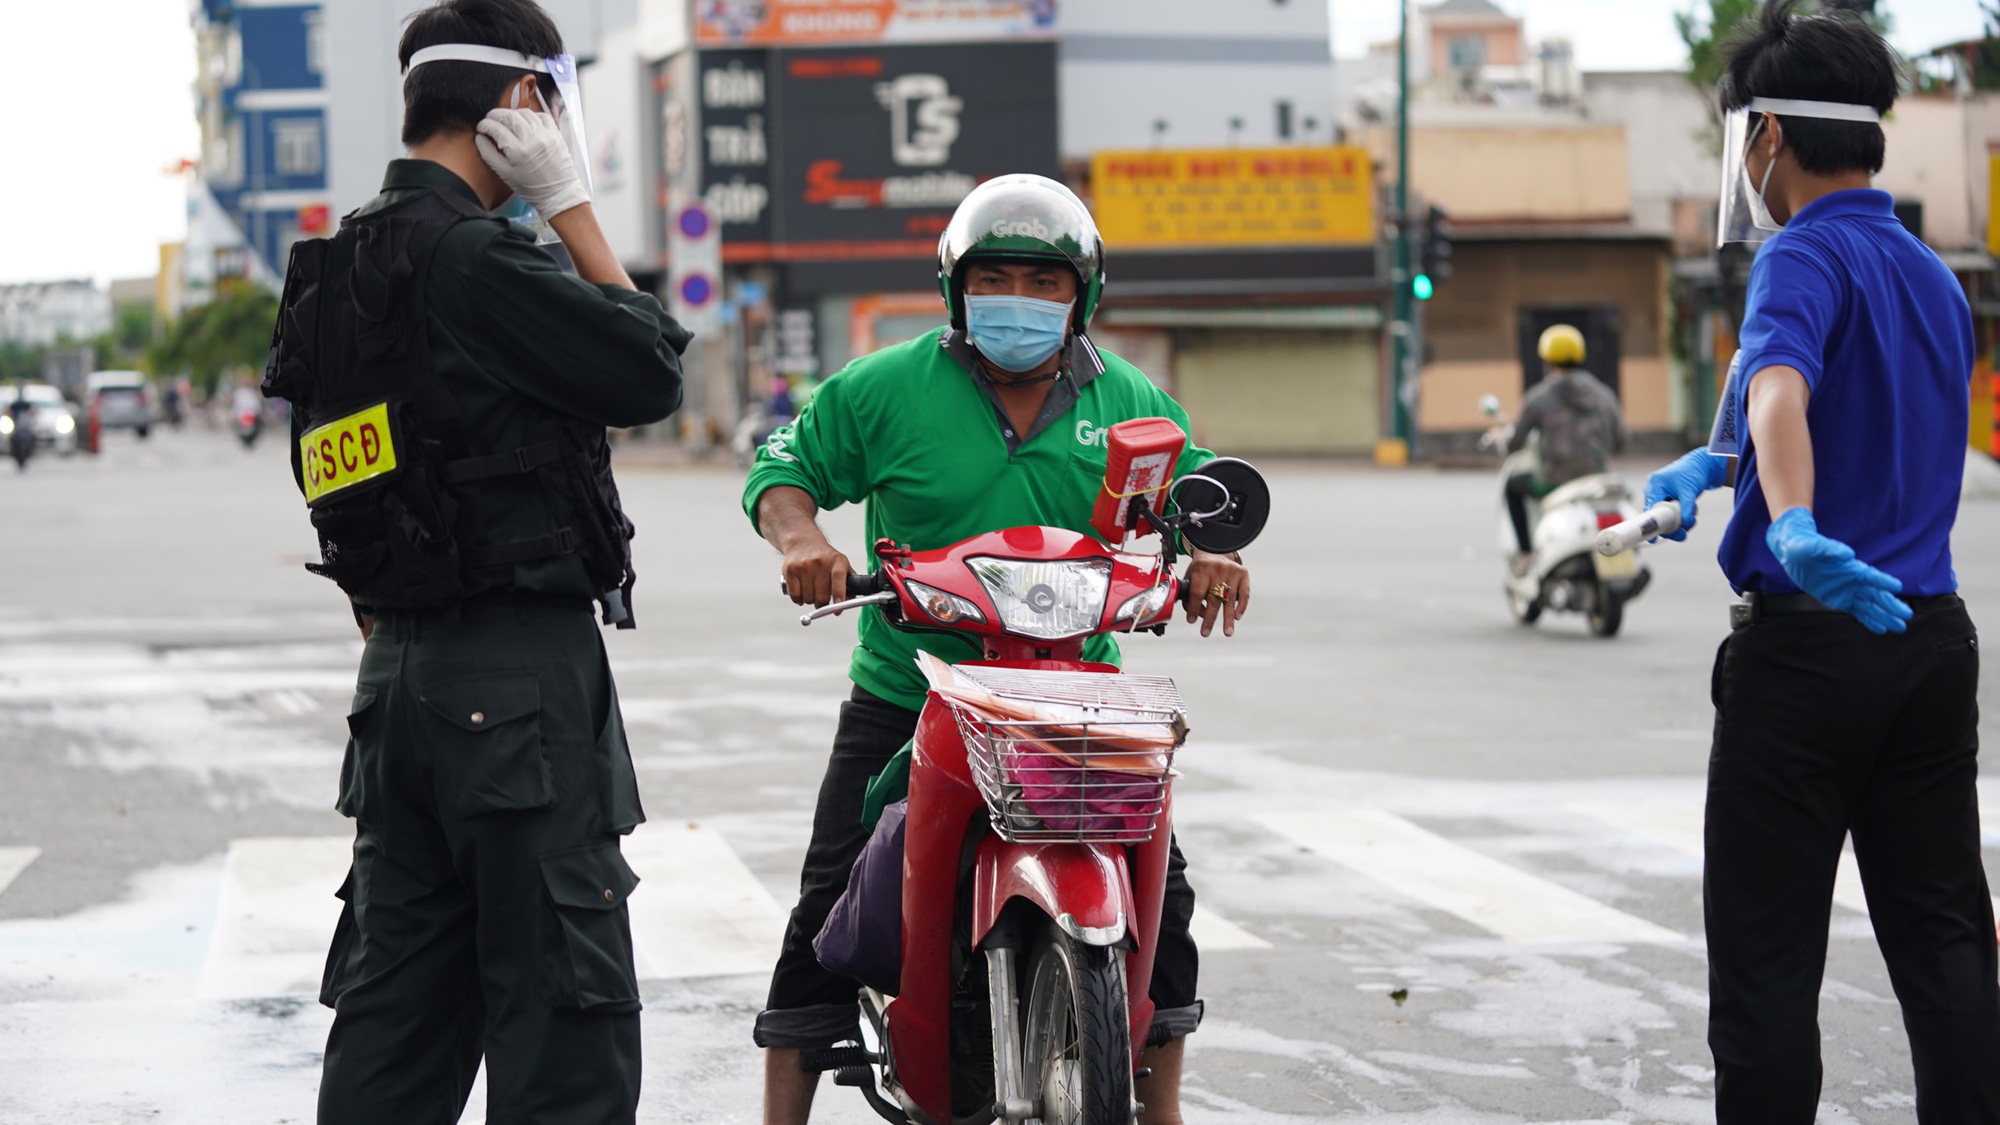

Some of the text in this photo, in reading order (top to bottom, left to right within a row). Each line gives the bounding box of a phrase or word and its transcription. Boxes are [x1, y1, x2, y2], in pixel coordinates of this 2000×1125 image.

[991, 219, 1048, 240] Grab
[1075, 420, 1108, 449] Gr
[307, 422, 381, 488] CSCĐ
